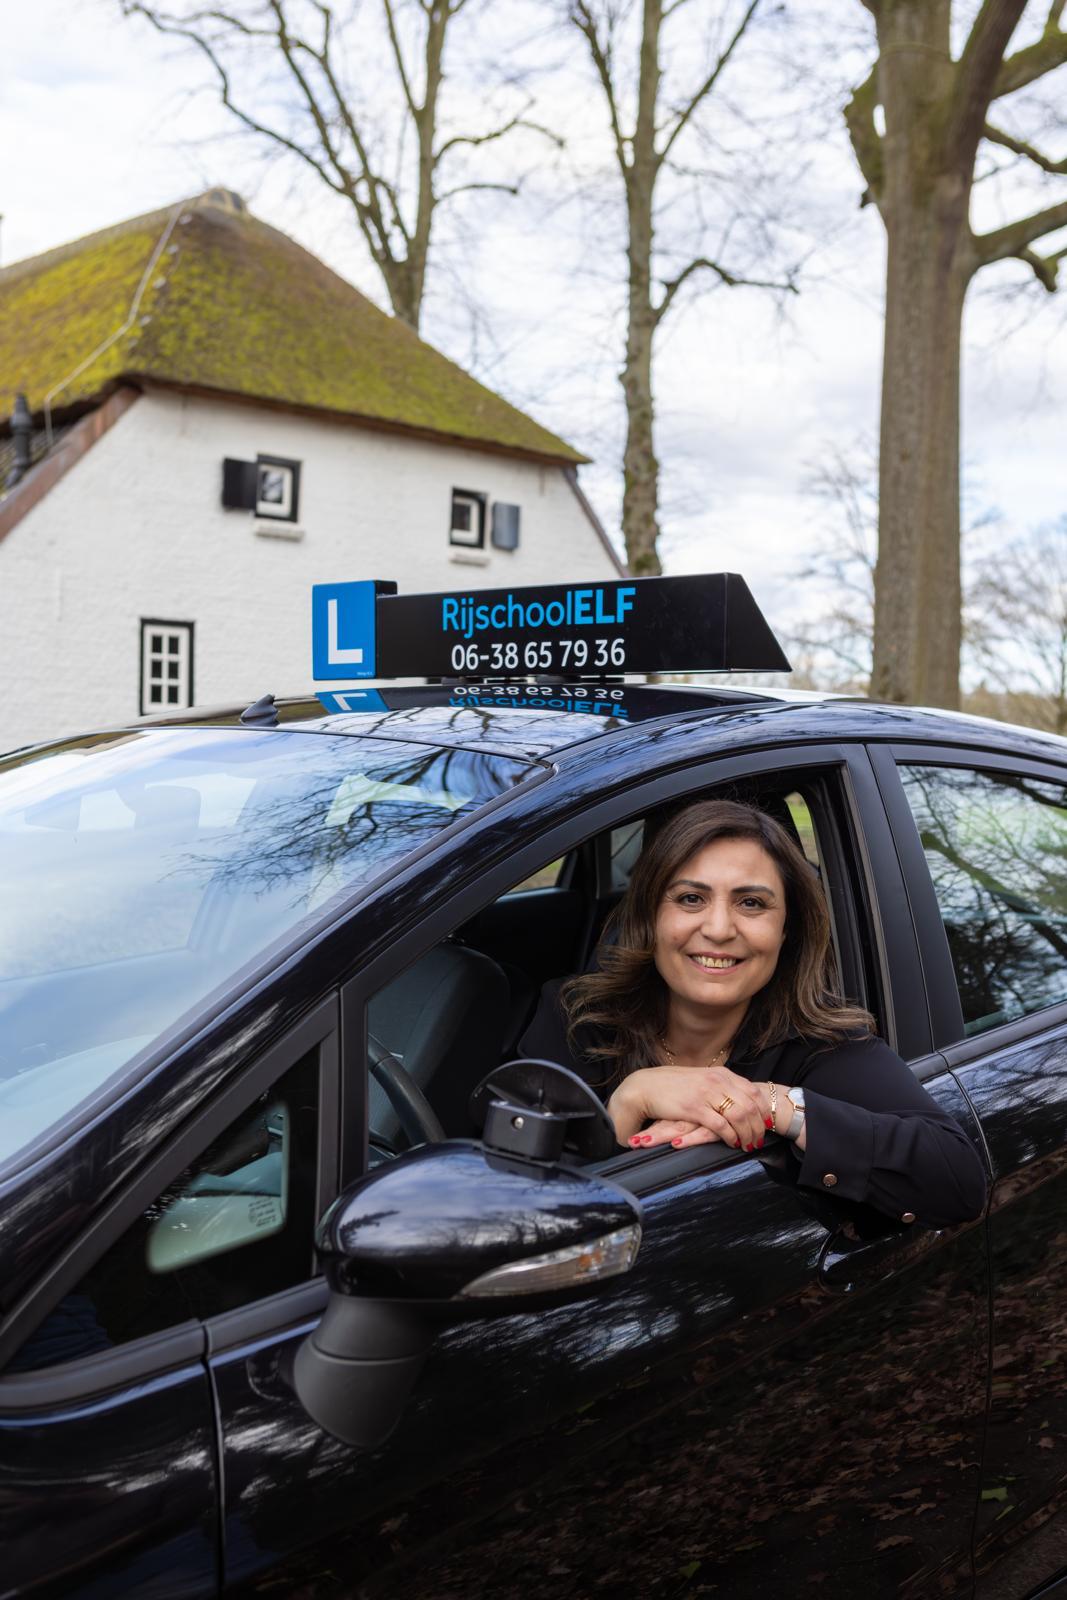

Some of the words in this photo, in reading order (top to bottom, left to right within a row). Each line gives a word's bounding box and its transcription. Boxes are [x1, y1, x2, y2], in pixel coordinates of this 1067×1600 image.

[327, 598, 363, 665] L
[442, 587, 637, 639] RijschoolELF
[451, 641, 519, 671] 06-38
[524, 640, 552, 669] 65
[559, 639, 588, 667] 79
[594, 638, 626, 667] 36
